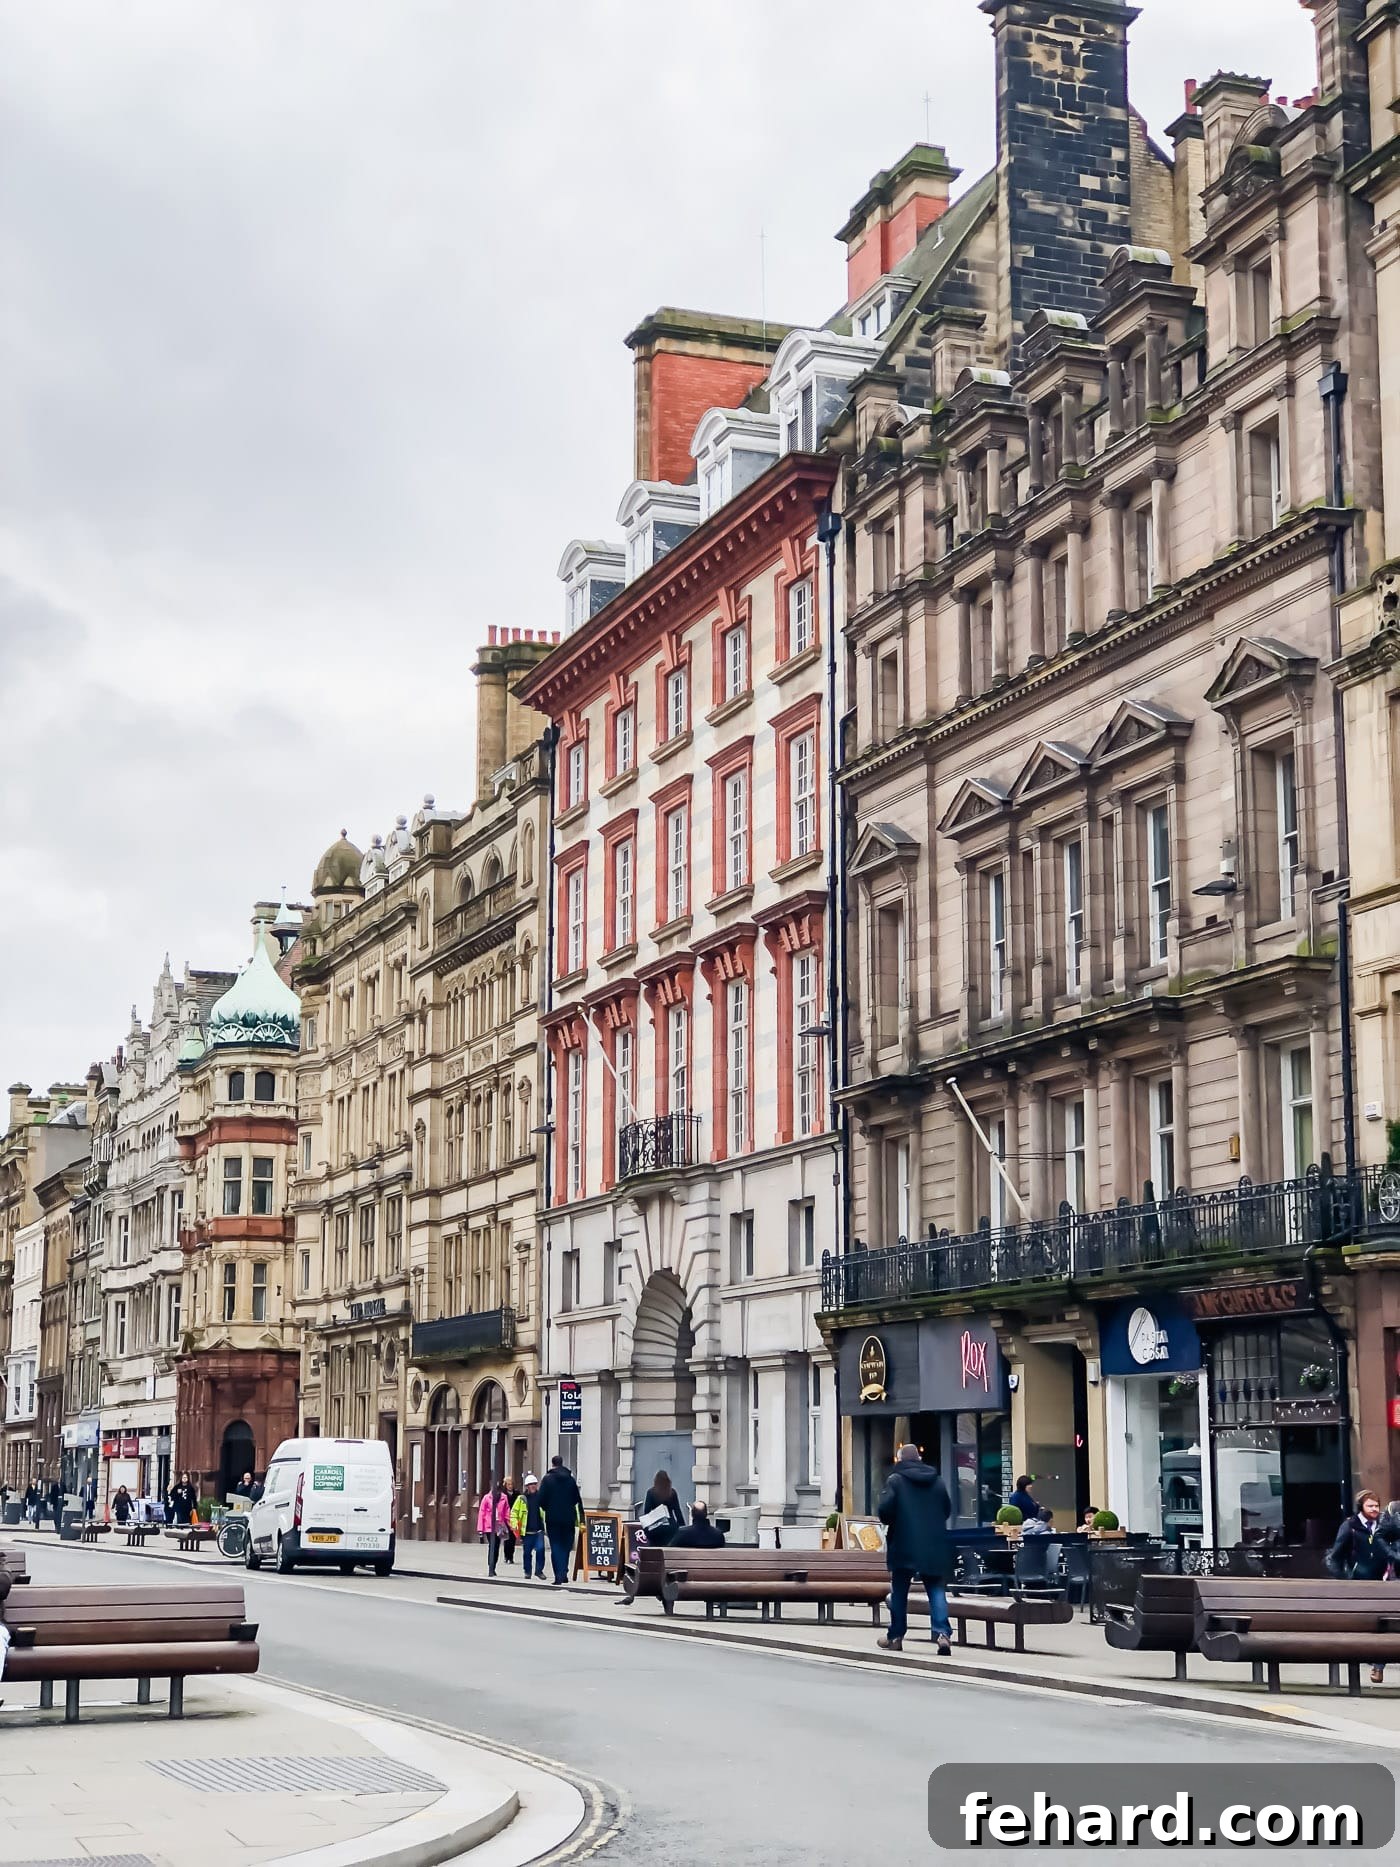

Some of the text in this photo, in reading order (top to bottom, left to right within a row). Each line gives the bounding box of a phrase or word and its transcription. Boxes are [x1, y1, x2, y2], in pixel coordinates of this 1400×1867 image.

[1141, 1330, 1168, 1343] PASTA
[1143, 1346, 1169, 1360] COSA
[562, 1392, 573, 1400] To
[594, 1525, 611, 1533] PIE
[591, 1547, 614, 1555] PINT
[596, 1556, 610, 1566] £8
